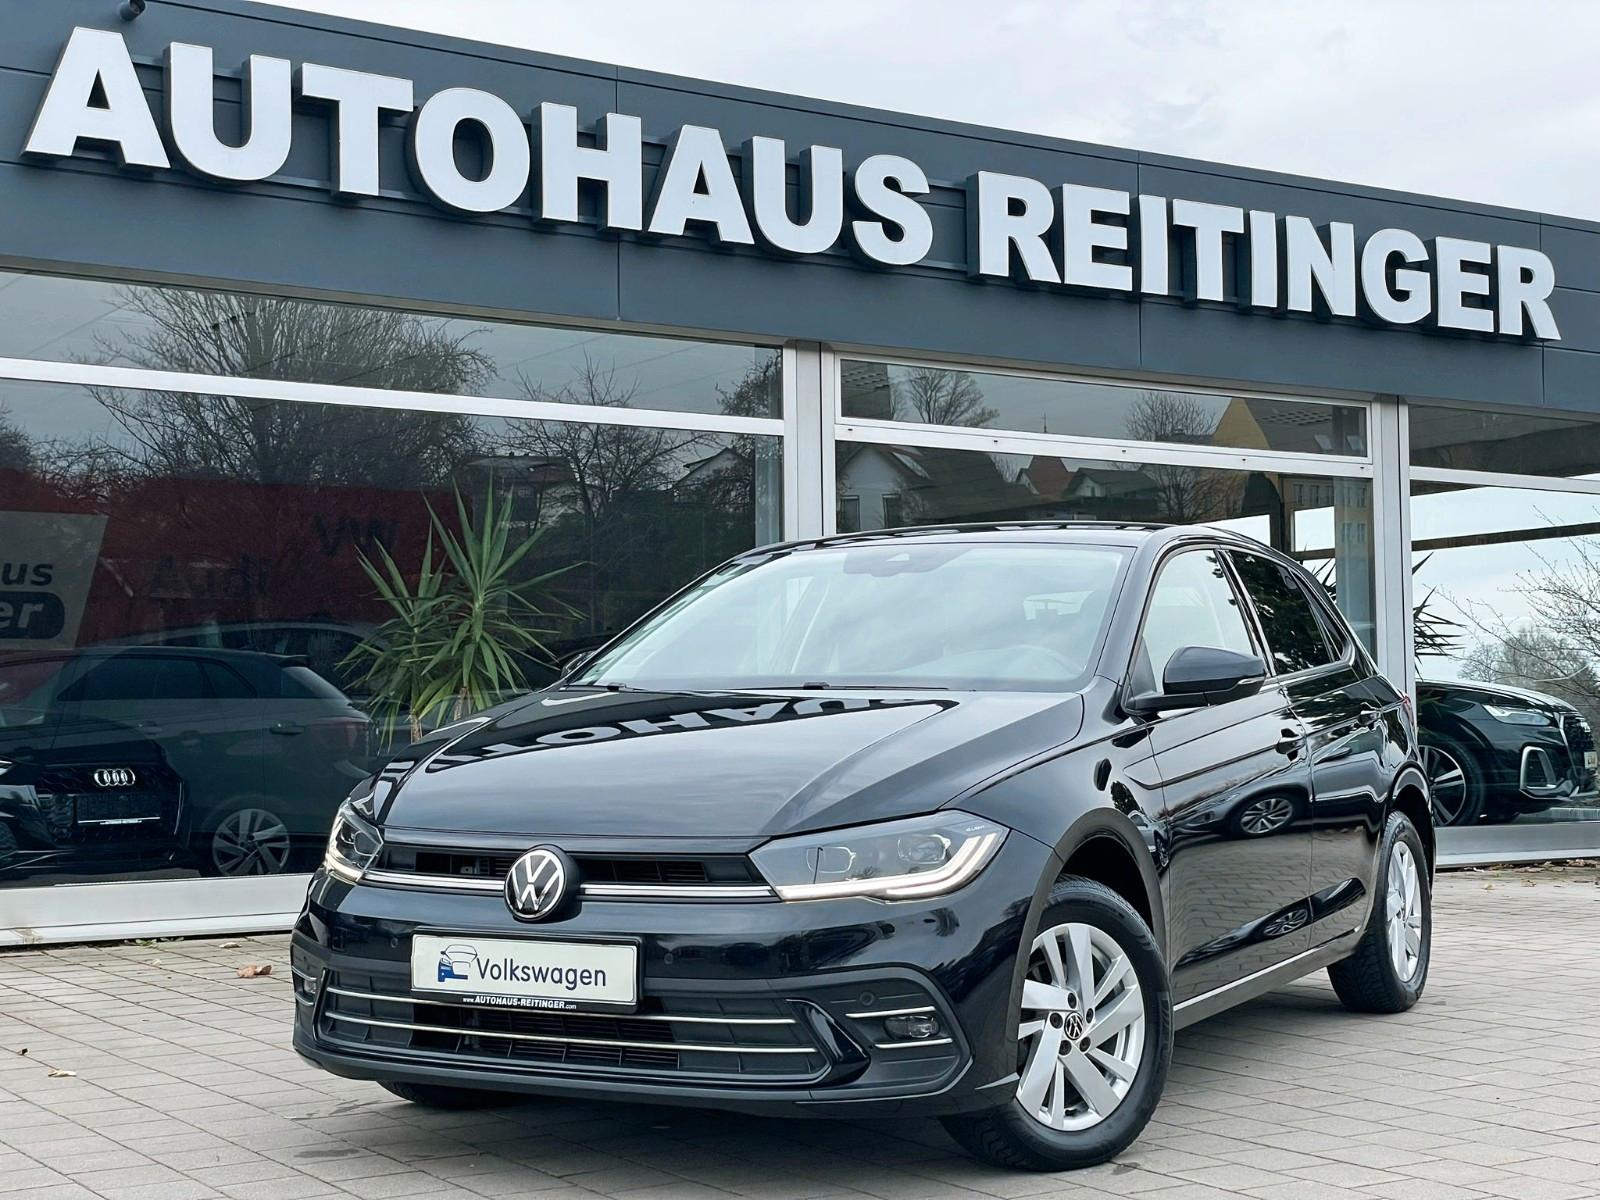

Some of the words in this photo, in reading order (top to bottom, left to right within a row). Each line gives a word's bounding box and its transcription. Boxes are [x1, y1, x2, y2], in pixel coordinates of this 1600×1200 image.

[21, 26, 934, 266] AUTOHAUS
[976, 170, 1562, 342] REITINGER
[476, 957, 607, 991] Volkswagen
